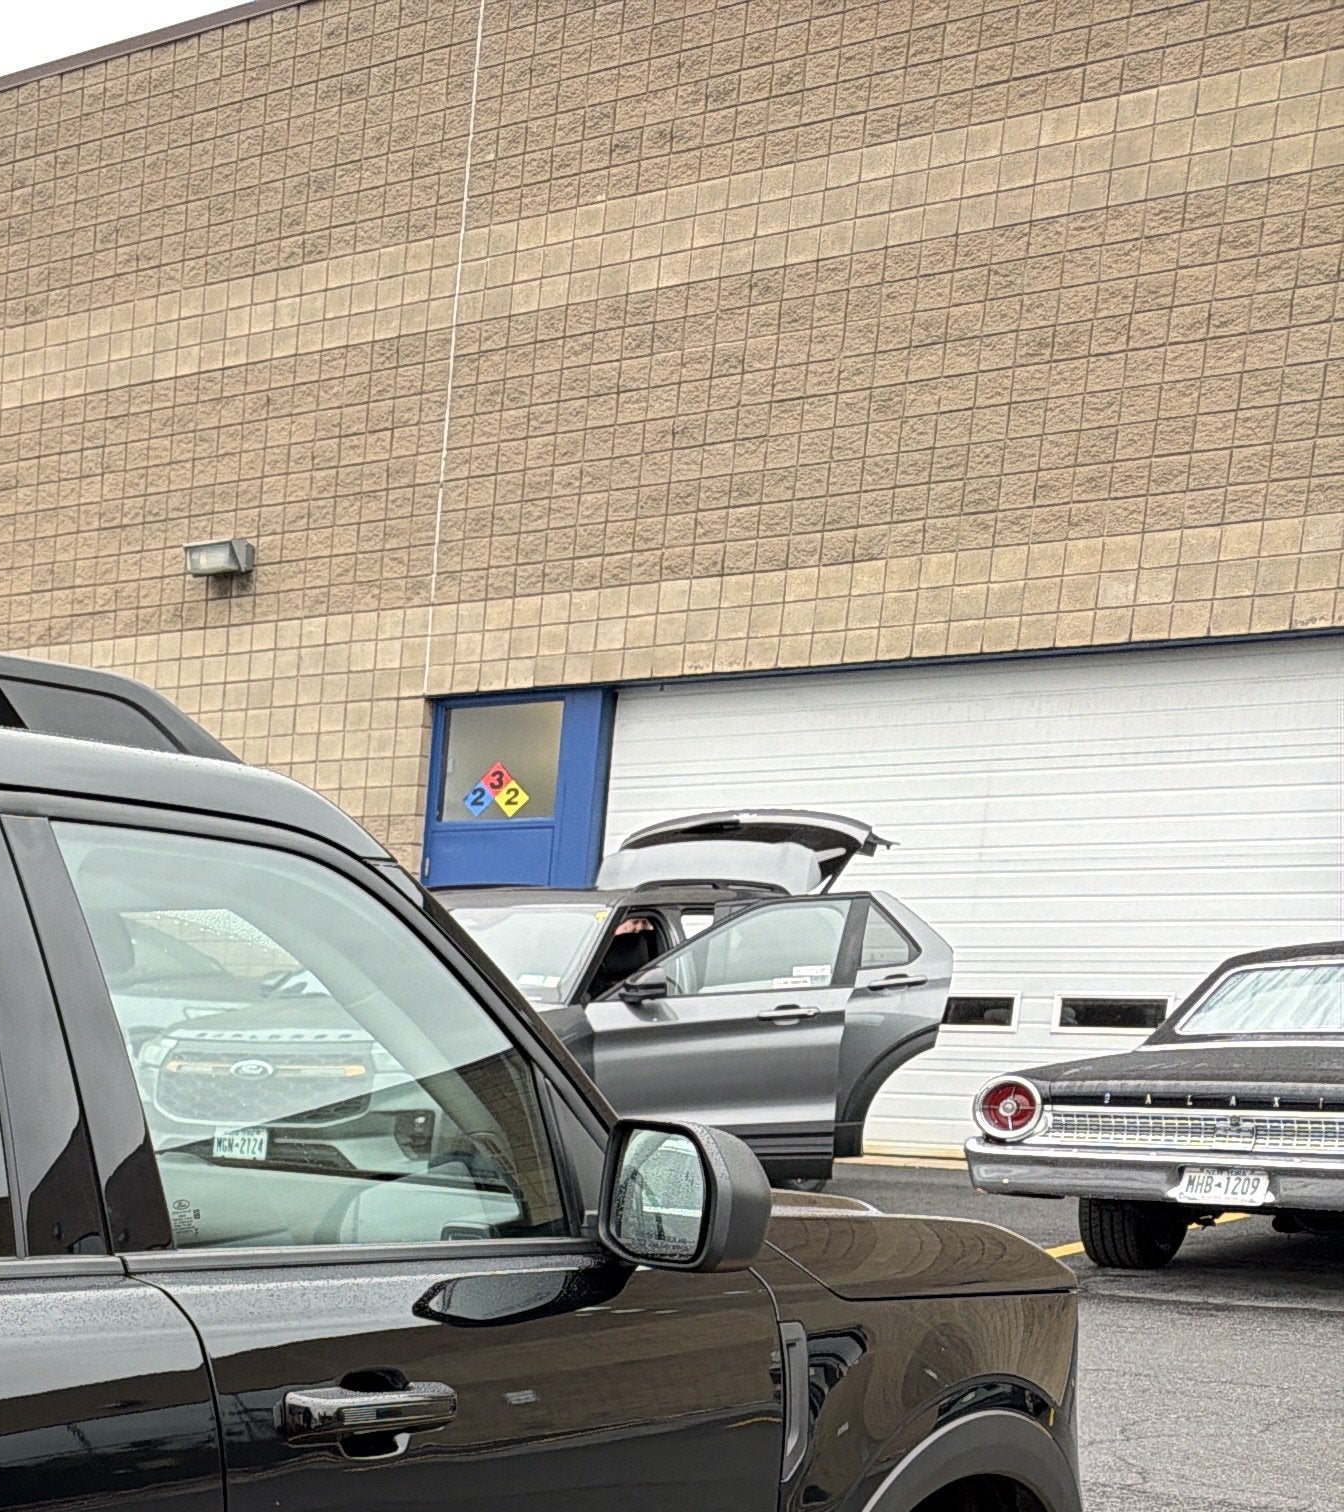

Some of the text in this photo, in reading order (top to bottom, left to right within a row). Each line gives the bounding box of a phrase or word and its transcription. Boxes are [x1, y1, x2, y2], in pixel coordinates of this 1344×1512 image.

[490, 770, 504, 789] 3
[471, 788, 485, 806] 2
[505, 788, 519, 805] 2
[1224, 1176, 1261, 1197] 1209
